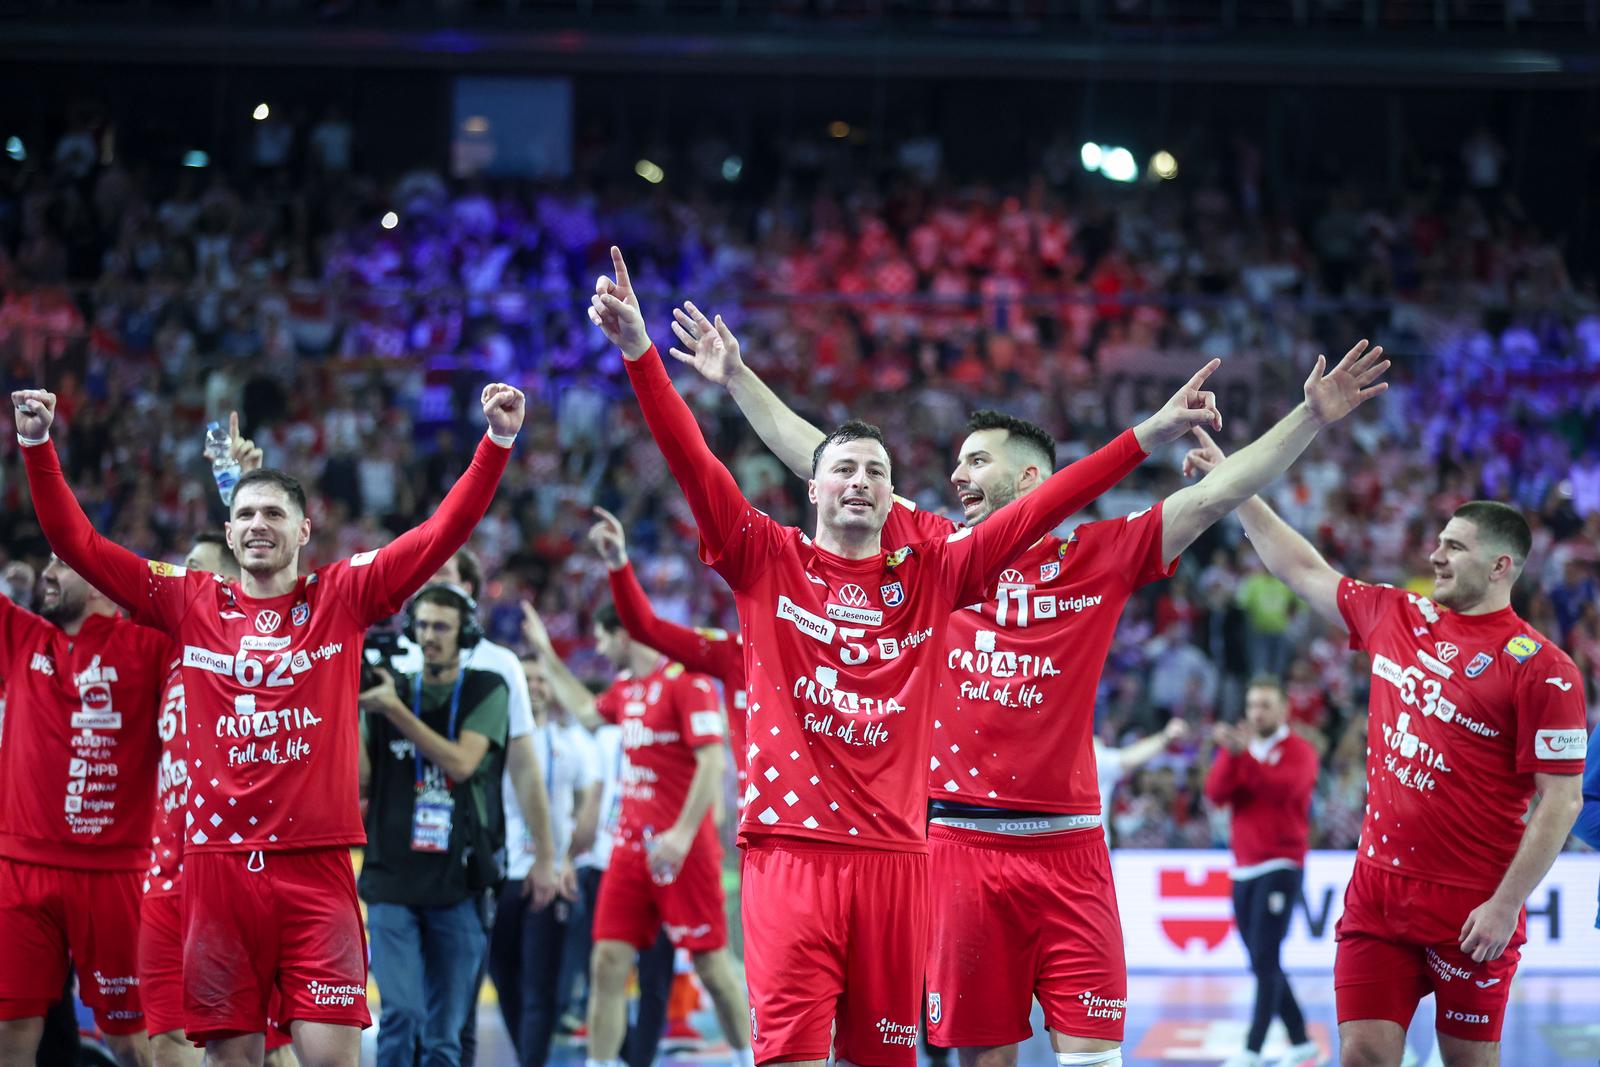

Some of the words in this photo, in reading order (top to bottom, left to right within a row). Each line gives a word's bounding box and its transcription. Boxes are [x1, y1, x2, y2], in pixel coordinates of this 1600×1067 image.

[828, 608, 841, 617] AC
[842, 609, 881, 623] Jesenović
[996, 588, 1028, 628] 11
[1058, 595, 1102, 614] triglav
[782, 602, 829, 637] telemach
[839, 627, 870, 666] 5
[900, 627, 933, 649] triglav
[235, 648, 295, 688] 62
[948, 649, 1060, 678] CROATIA
[794, 675, 906, 716] CROATIA
[216, 706, 322, 737] CROATIA
[87, 762, 119, 777] HPB
[83, 798, 115, 812] triglav
[315, 994, 355, 1007] Lutrija
[1087, 1006, 1122, 1021] Lutrija
